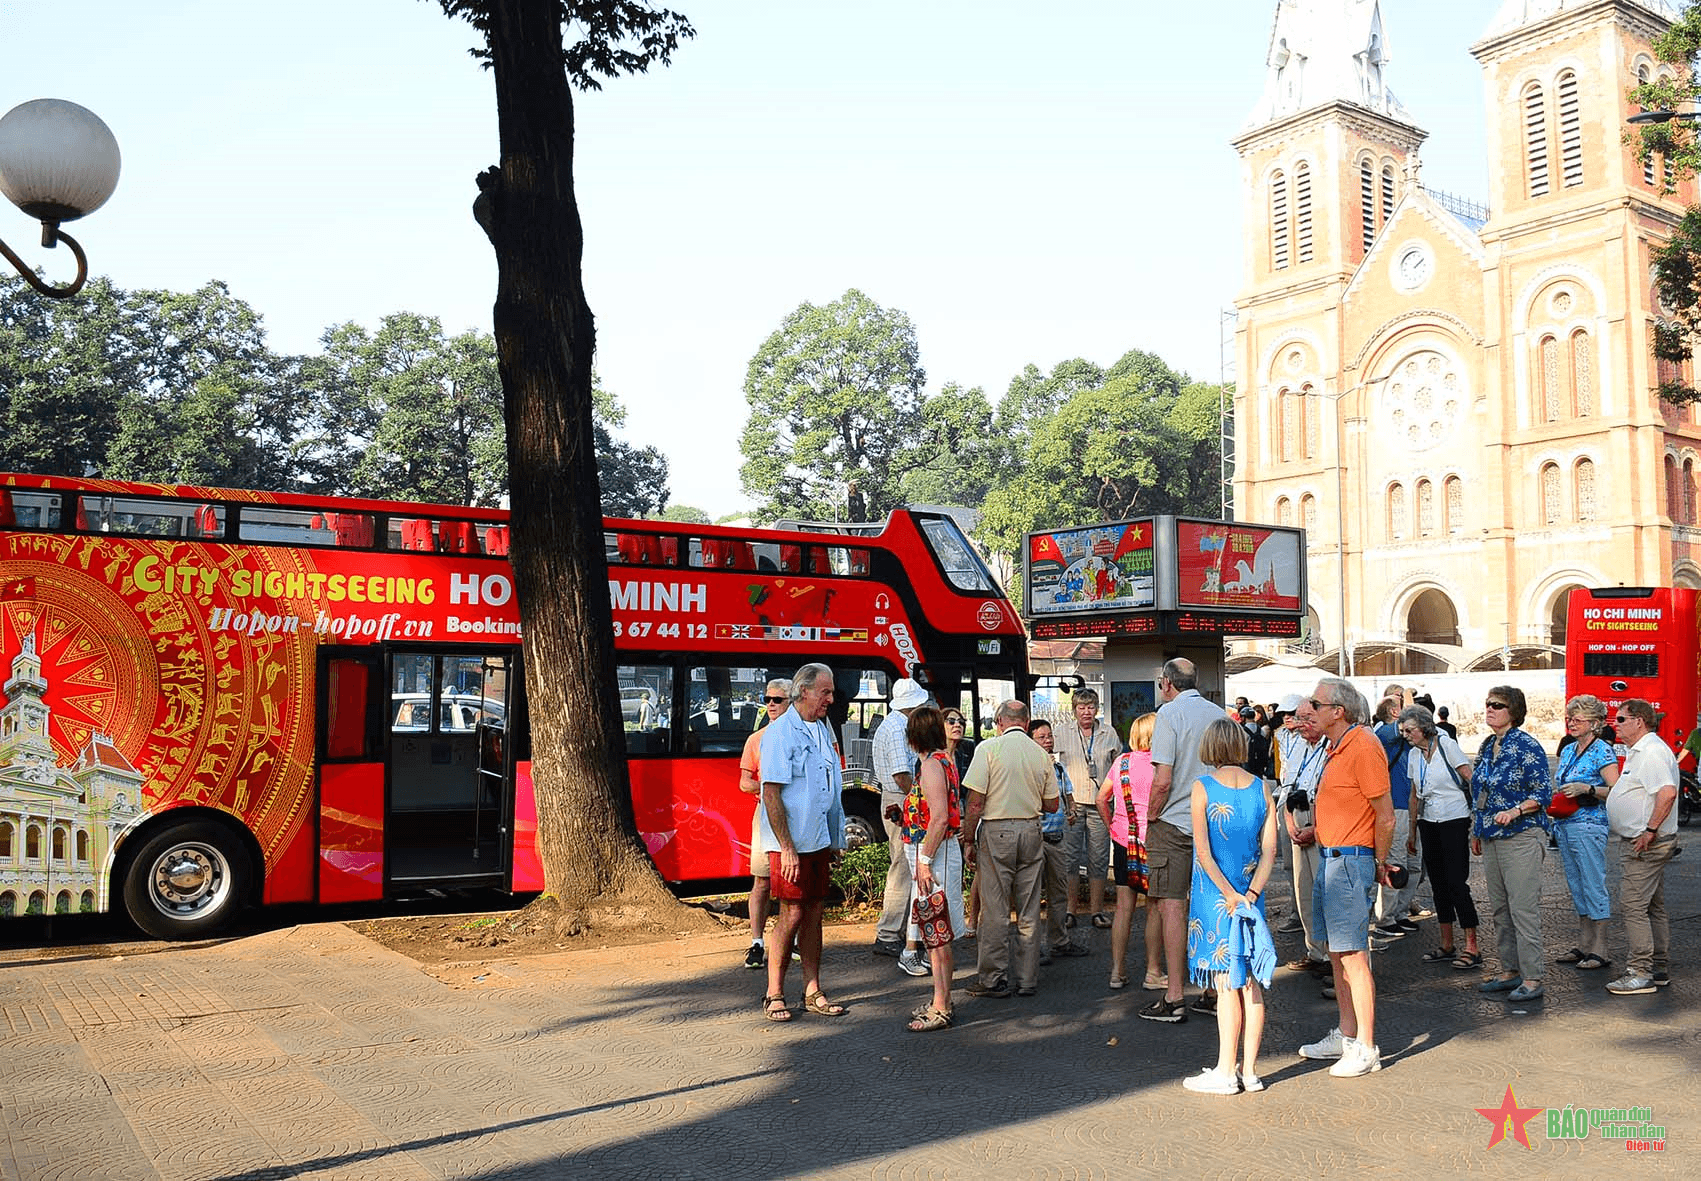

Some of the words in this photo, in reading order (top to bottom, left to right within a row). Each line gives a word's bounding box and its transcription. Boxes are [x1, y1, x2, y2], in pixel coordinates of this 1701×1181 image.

[449, 573, 512, 606] HO
[608, 579, 707, 613] MINH
[207, 606, 434, 641] Hopon-hopoff.vn
[1584, 608, 1600, 619] HO
[1603, 608, 1625, 619] CHI
[1628, 608, 1662, 620] MINH
[627, 621, 653, 638] 67
[656, 622, 681, 639] 44
[686, 623, 708, 640] 12
[1622, 644, 1638, 652] HOP
